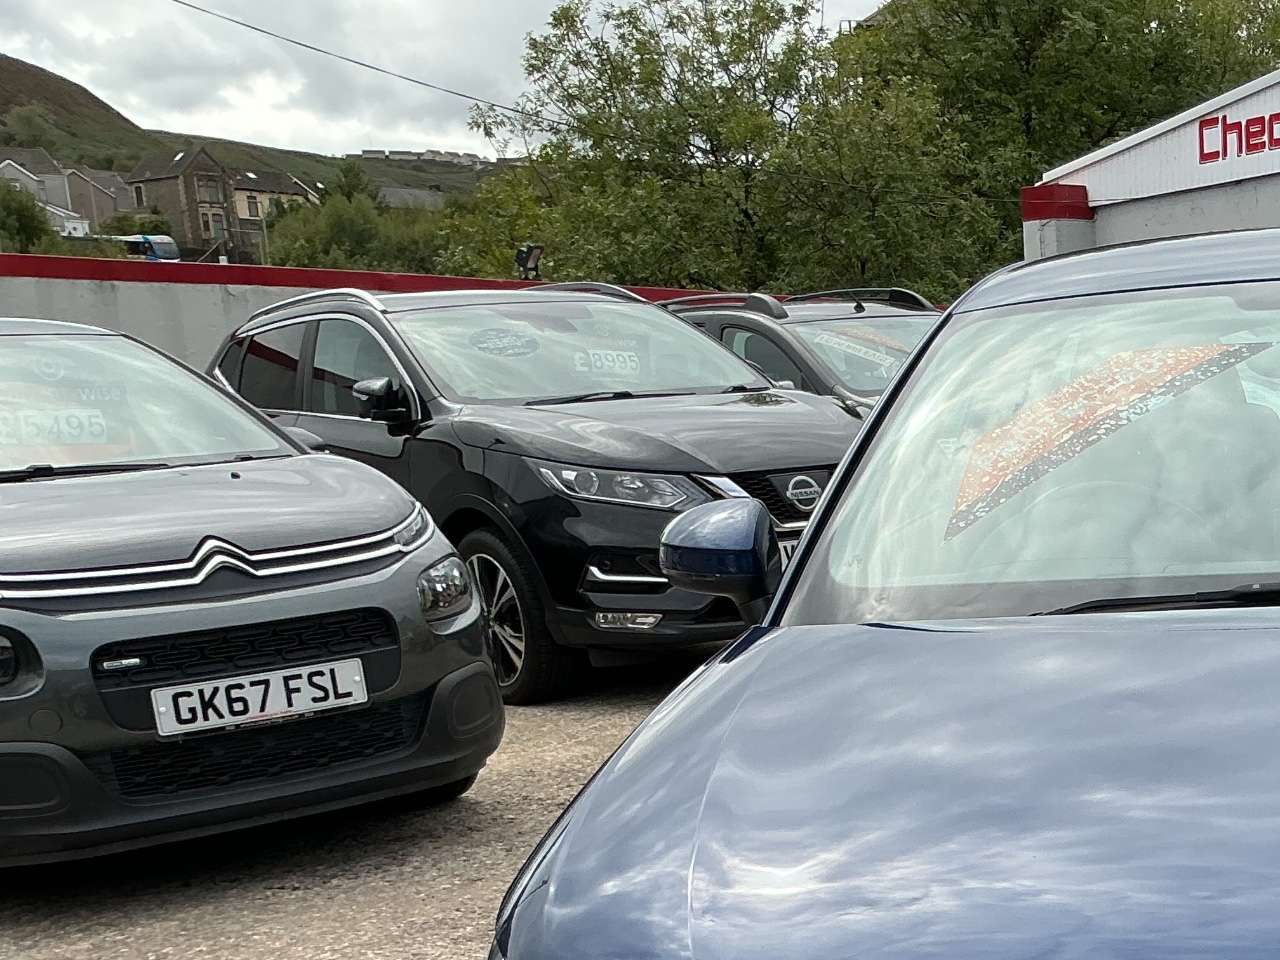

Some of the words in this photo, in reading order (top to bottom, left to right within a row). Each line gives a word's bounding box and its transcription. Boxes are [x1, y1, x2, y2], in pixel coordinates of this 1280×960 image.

[574, 351, 639, 372] £8995
[171, 679, 271, 725] GK67
[282, 668, 353, 708] FSL
